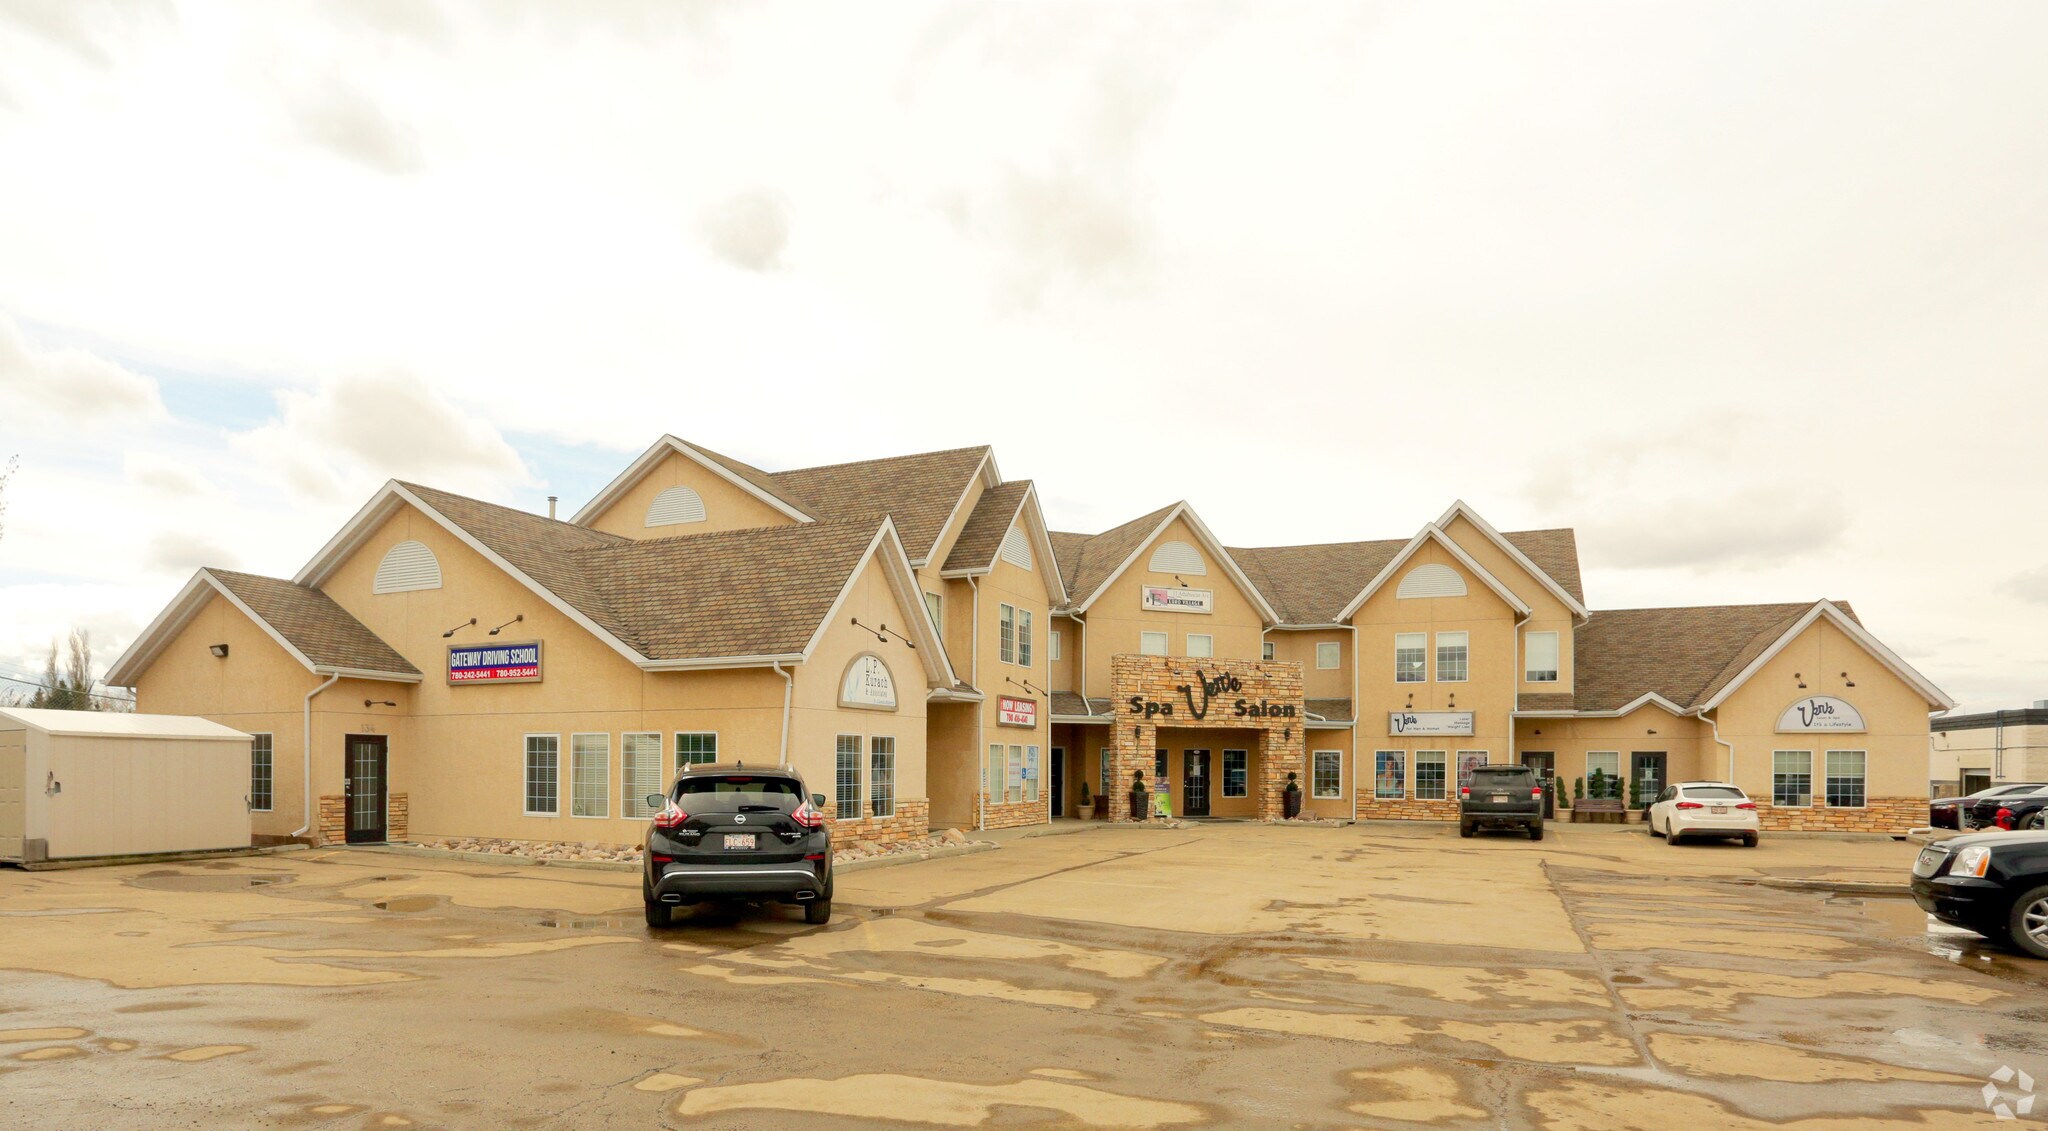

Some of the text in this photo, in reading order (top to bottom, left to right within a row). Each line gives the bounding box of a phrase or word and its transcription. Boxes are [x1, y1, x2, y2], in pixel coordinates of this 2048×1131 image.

[451, 647, 537, 667] GATEWAY DRIVING SCHOOL
[451, 668, 537, 679] 780-242-5441 780-952-5441
[1002, 699, 1034, 714] NOW LEASING
[1130, 696, 1173, 719] Spa
[1235, 699, 1296, 718] Salon
